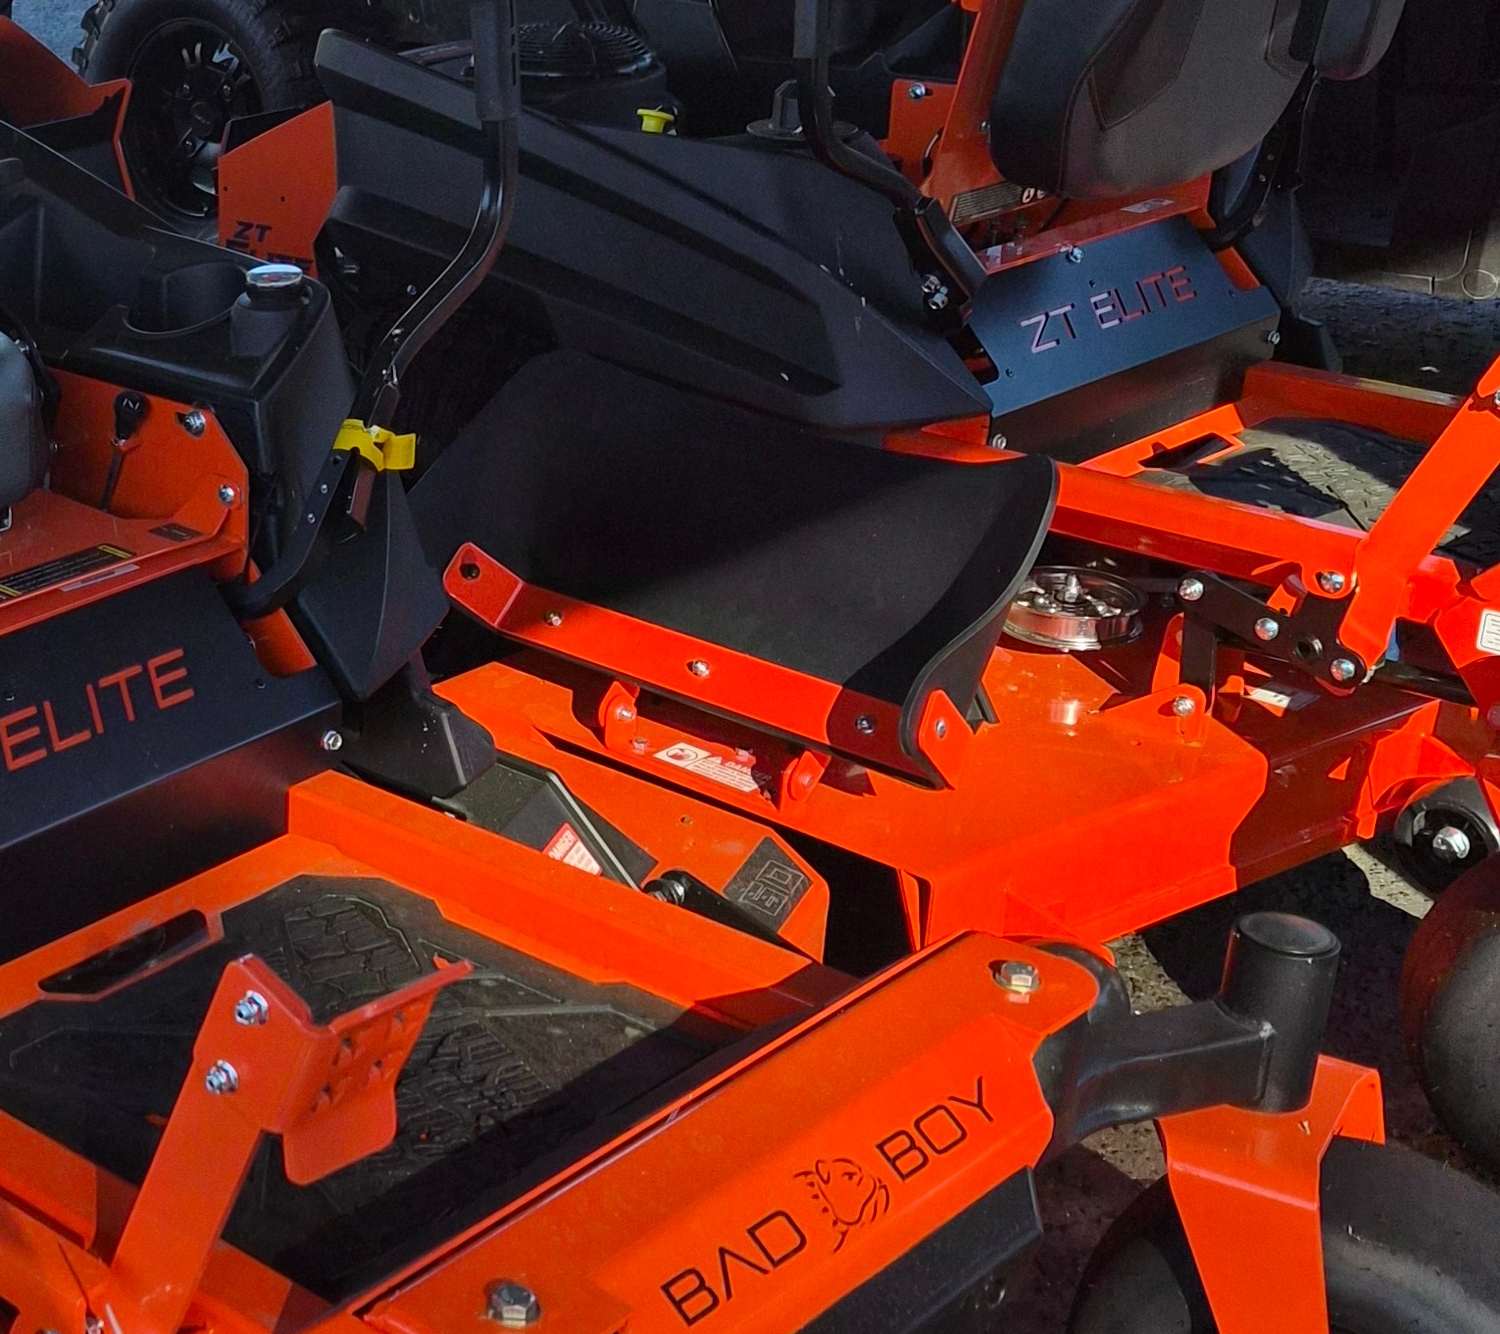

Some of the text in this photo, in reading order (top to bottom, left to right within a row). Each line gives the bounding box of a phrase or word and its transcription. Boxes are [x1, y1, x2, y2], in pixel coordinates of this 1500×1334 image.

[234, 220, 273, 243] ZT
[1019, 265, 1197, 354] ZT ELITE
[660, 1075, 996, 1327] BAD BOY
